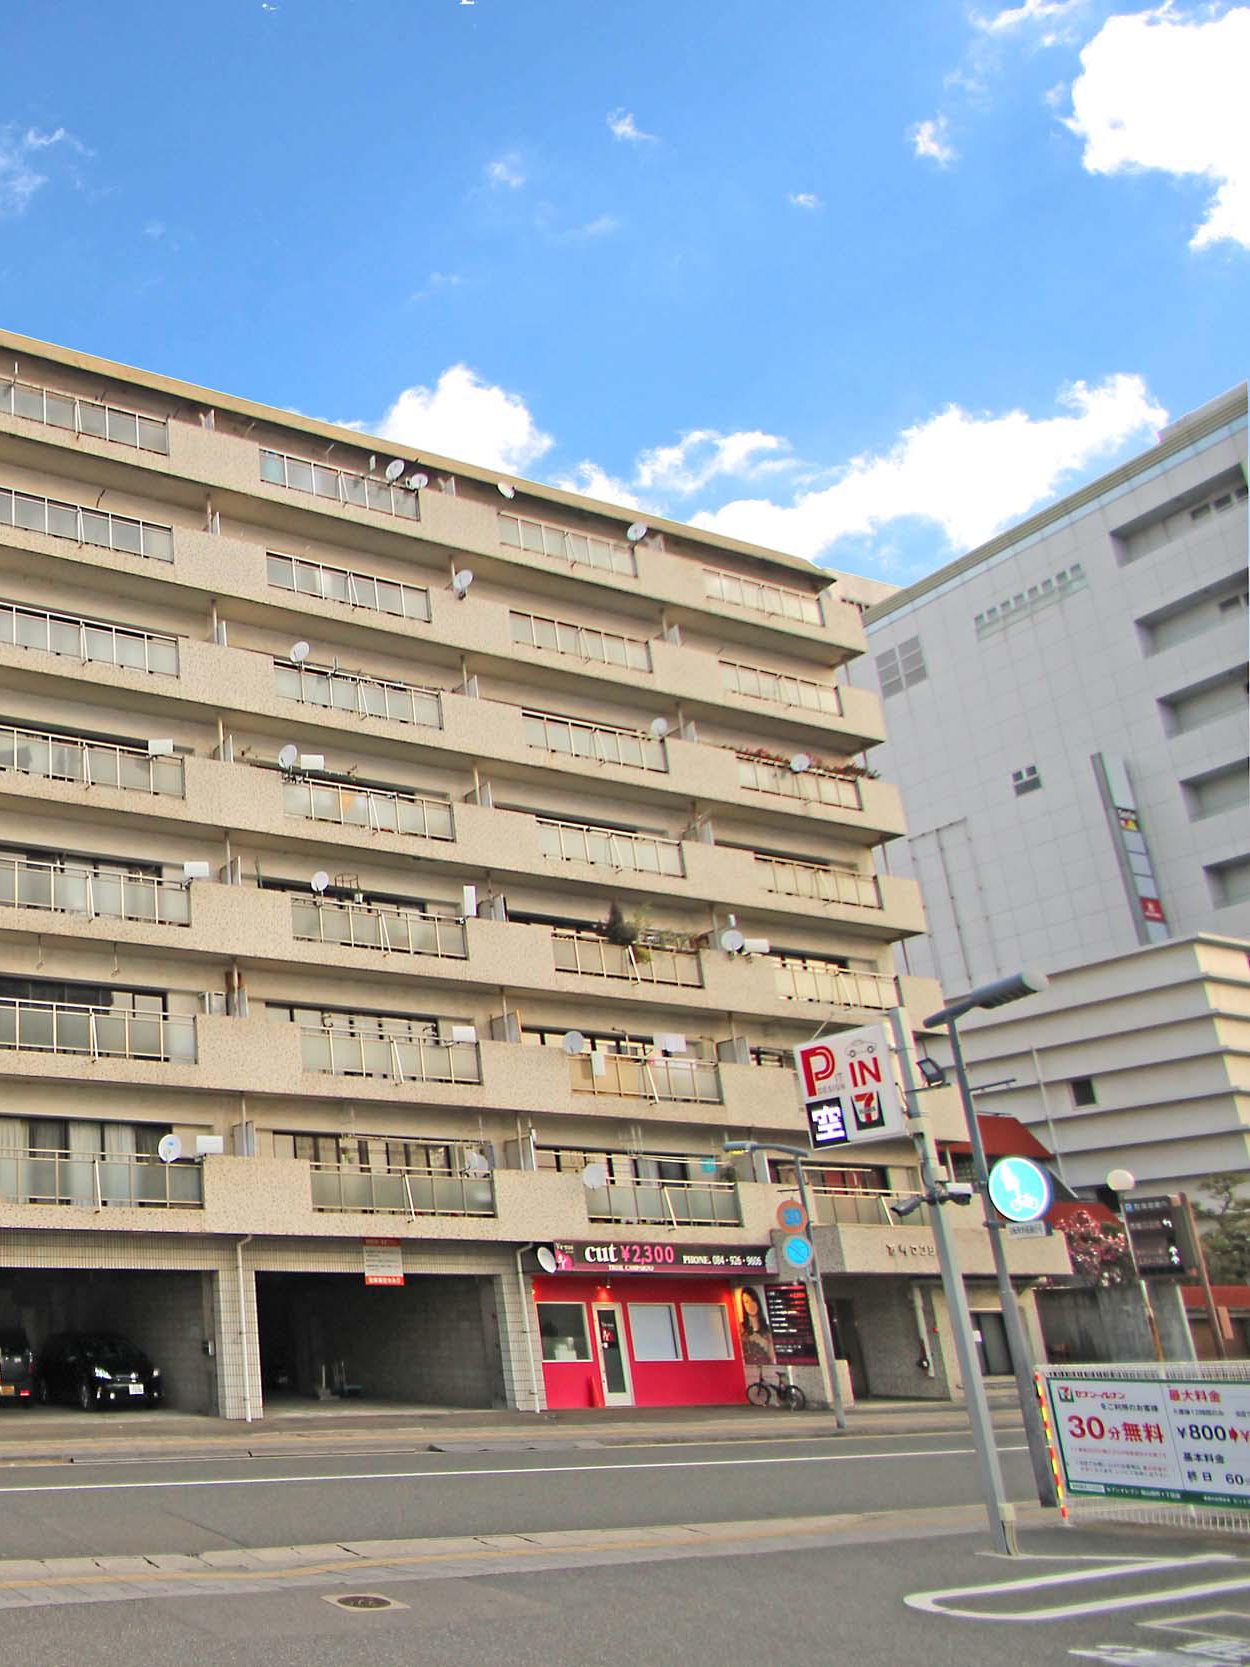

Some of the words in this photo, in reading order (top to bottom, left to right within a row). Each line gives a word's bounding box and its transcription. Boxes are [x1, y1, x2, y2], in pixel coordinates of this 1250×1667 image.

[800, 1045, 835, 1097] P
[848, 1057, 882, 1088] IN
[811, 1105, 846, 1141] 空
[584, 1243, 618, 1262] cut
[620, 1245, 674, 1264] ¥2,300
[1168, 1389, 1222, 1403] 最大料金
[1067, 1415, 1164, 1444] 30分無料
[1176, 1424, 1227, 1442] ¥800
[1183, 1451, 1226, 1464] 基本料金
